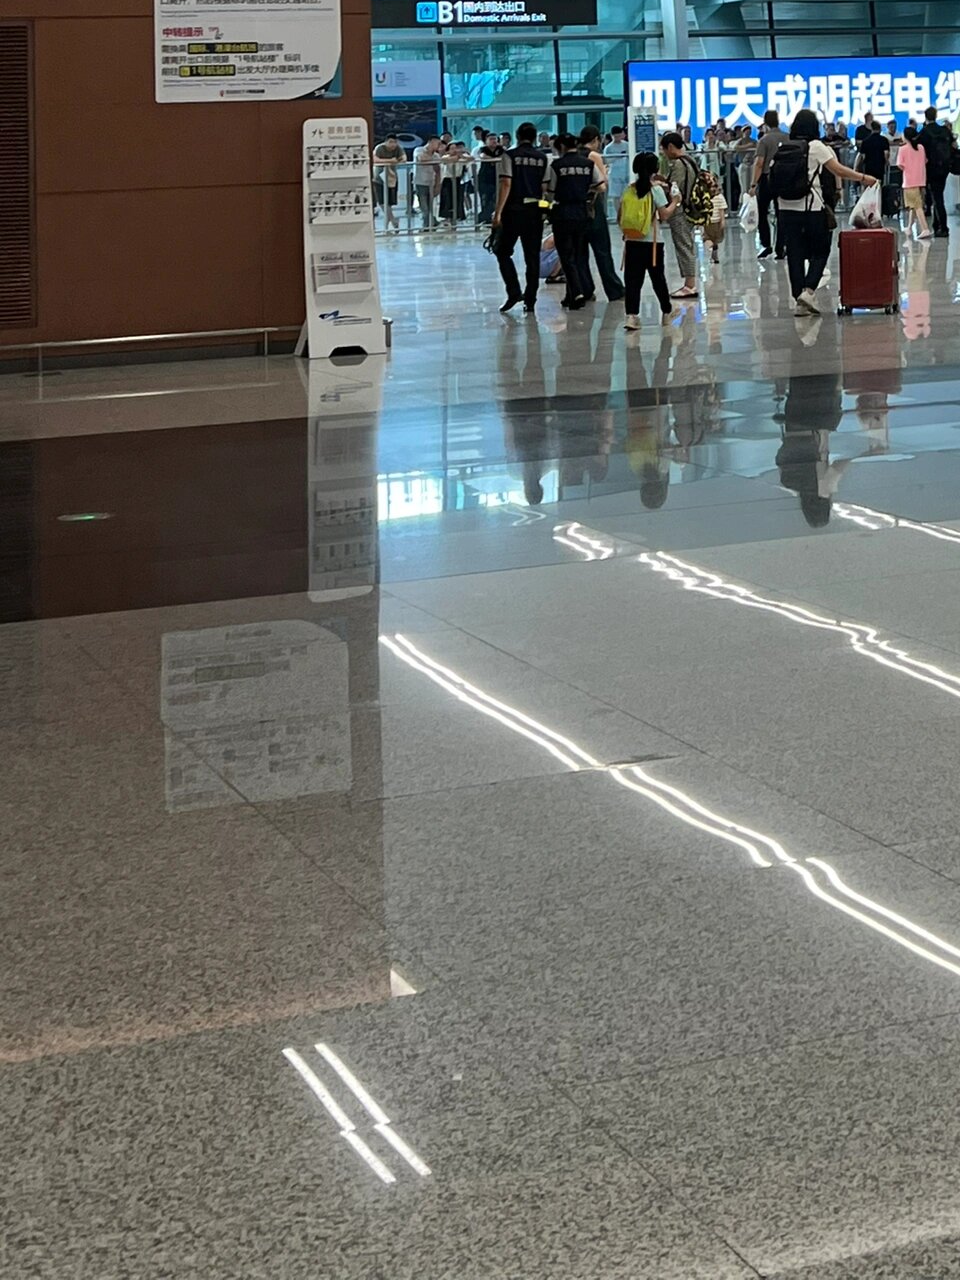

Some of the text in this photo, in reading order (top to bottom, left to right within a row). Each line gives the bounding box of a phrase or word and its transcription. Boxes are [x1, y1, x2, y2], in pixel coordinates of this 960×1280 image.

[438, 1, 525, 23] B1 国内到达出口
[464, 13, 546, 23] Domestic Arrivals Exit
